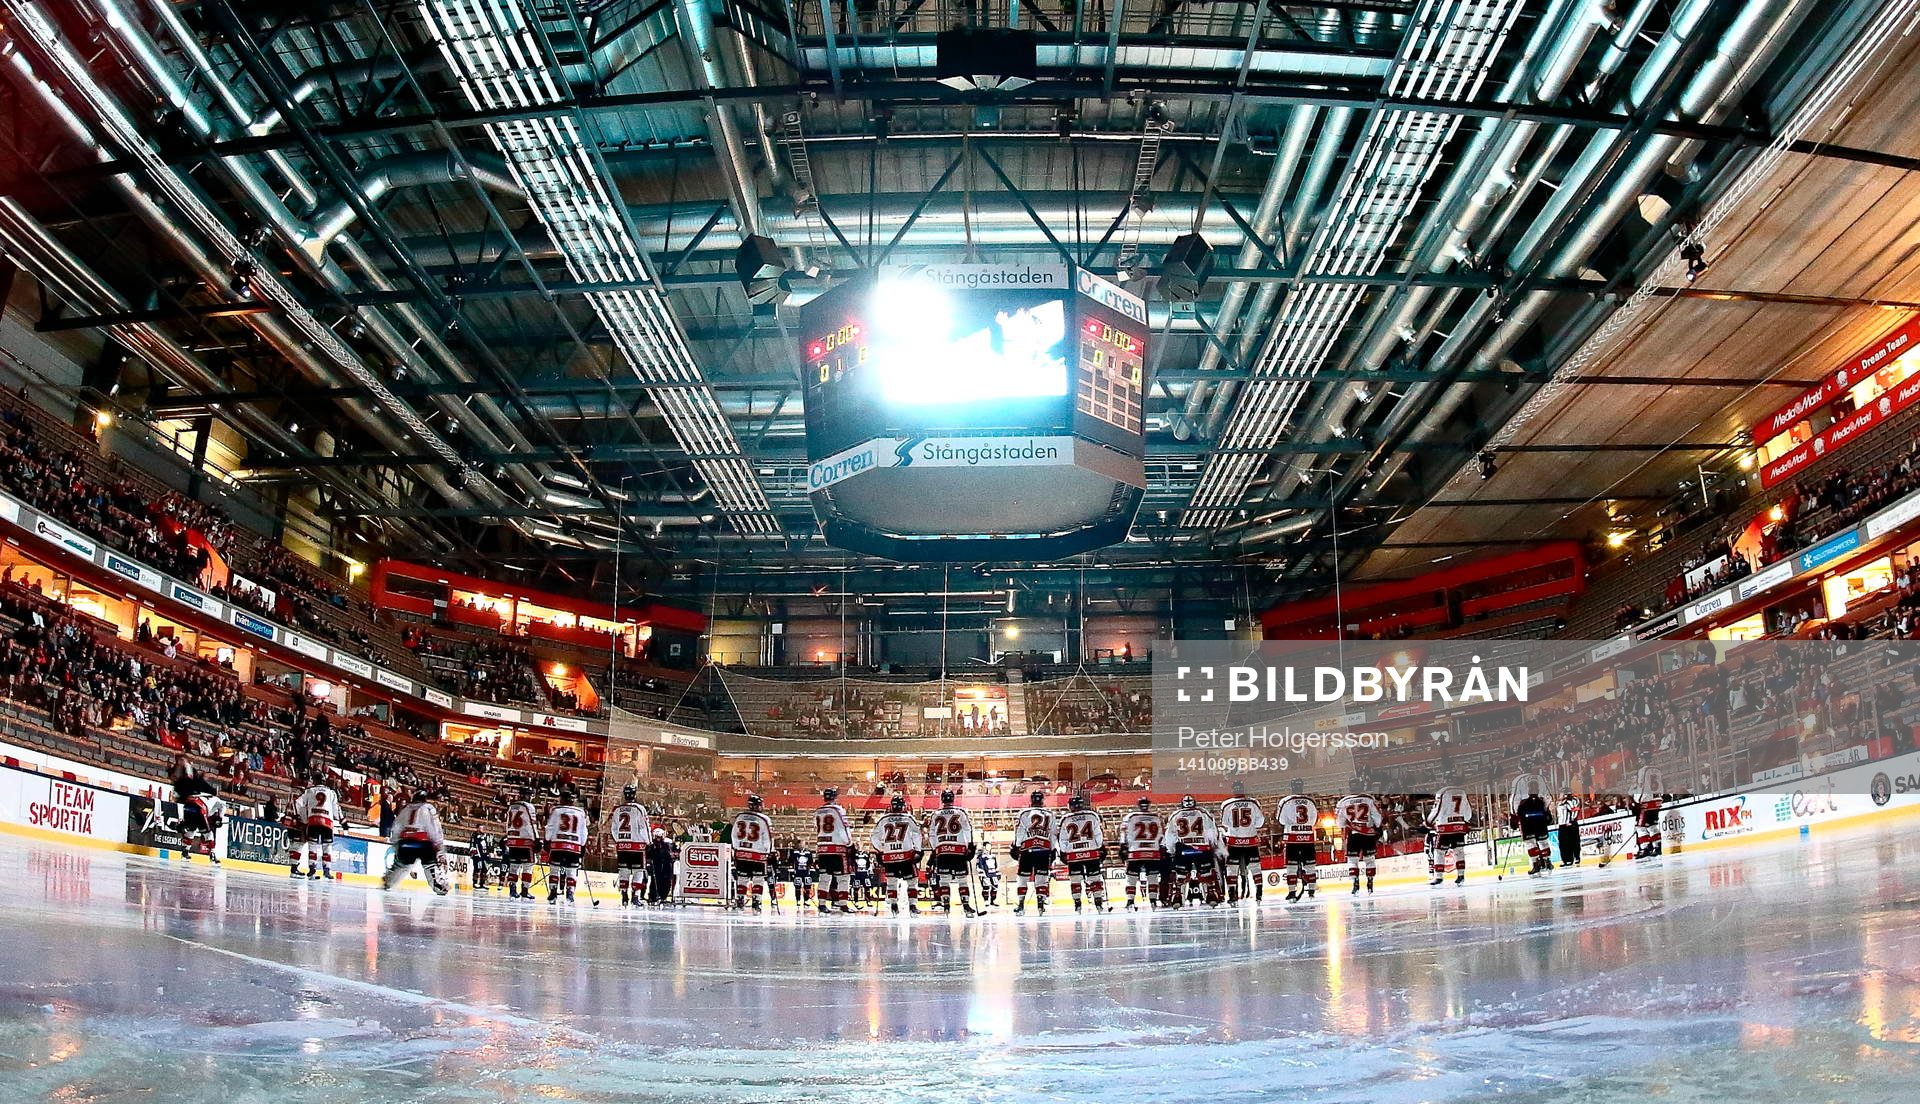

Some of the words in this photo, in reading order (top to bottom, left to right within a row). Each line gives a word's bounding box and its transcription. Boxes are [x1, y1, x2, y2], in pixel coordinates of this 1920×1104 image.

[926, 267, 1053, 288] Stångåstaden
[1861, 348, 1887, 369] Dream
[1886, 334, 1908, 352] Team
[923, 440, 1057, 464] Stångåstaden
[810, 448, 873, 488] Corren
[115, 562, 139, 580] Danske
[1695, 598, 1721, 616] Corren
[55, 783, 95, 811] TEAM
[1452, 796, 1462, 814] 7
[29, 801, 92, 834] SPORTIA
[560, 813, 578, 833] 31
[619, 813, 631, 832] 2
[1232, 808, 1251, 827] 15
[1296, 805, 1309, 824] 3
[1705, 805, 1742, 830] RIX
[736, 821, 760, 841] 33
[884, 822, 909, 843] 27
[935, 815, 962, 835] 26
[1066, 821, 1094, 843] 24
[1134, 821, 1158, 840] 29
[1176, 817, 1203, 837] 34
[690, 853, 719, 862] SIGN
